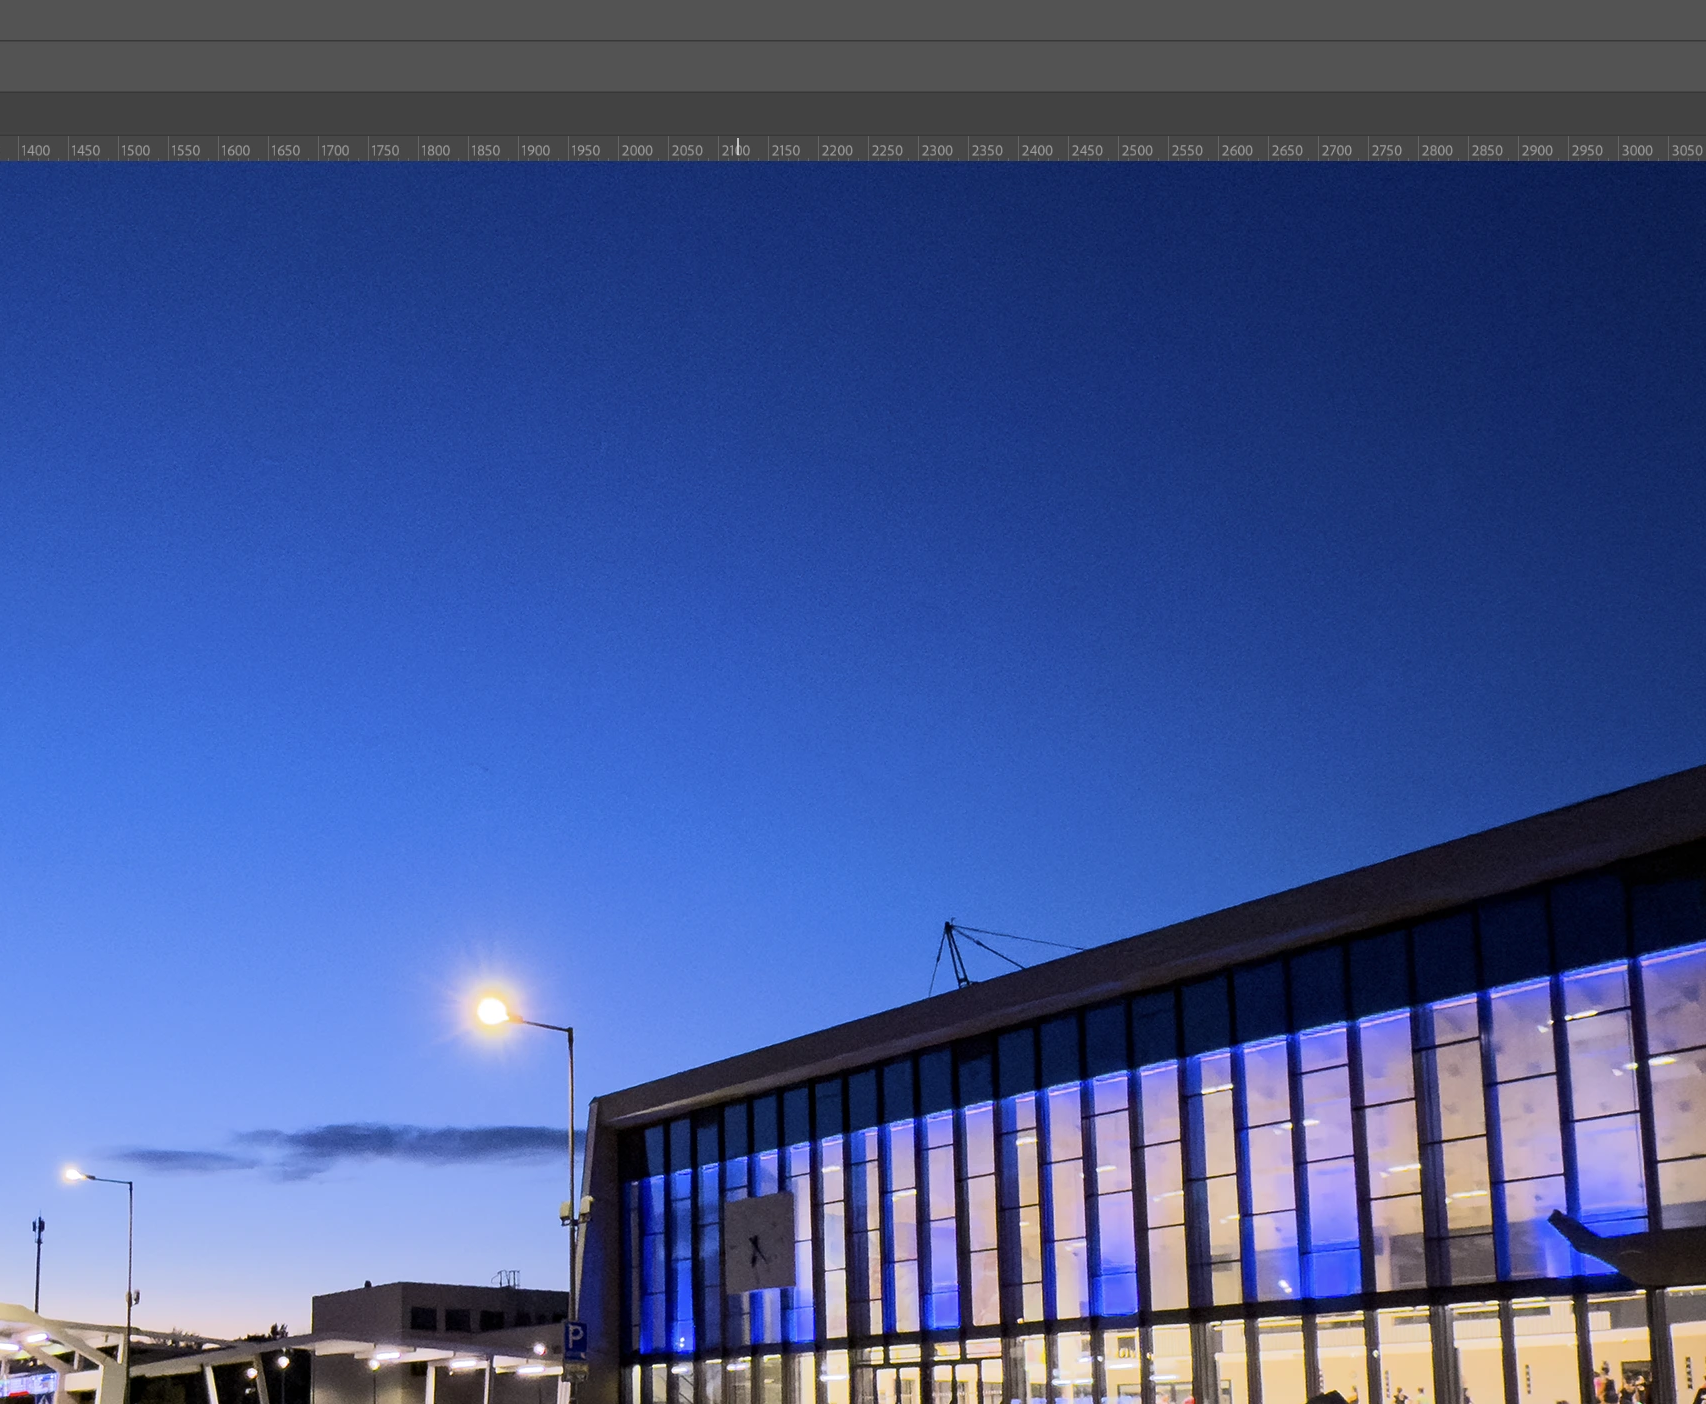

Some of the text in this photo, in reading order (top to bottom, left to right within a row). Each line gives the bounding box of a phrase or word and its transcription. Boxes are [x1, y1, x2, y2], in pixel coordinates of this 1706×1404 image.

[72, 145, 100, 156] 1450
[122, 145, 150, 156] 1500
[222, 145, 250, 156] 1600
[272, 145, 300, 156] 1650
[372, 145, 399, 156] 1750
[422, 145, 450, 156] 1800
[522, 145, 550, 156] 1900
[572, 145, 600, 156] 1950
[673, 145, 703, 156] 2050
[723, 145, 750, 156] 2100
[823, 145, 853, 156] 2200
[873, 145, 902, 156] 2250
[973, 145, 1002, 156] 2350
[1023, 145, 1053, 156] 2400
[1123, 145, 1153, 156] 2500
[1173, 145, 1203, 156] 2550
[1273, 145, 1302, 156] 2650
[1323, 145, 1352, 156] 2700
[1423, 145, 1453, 156] 2800
[1473, 145, 1503, 156] 2850
[1573, 145, 1603, 156] 2950
[1623, 145, 1653, 156] 3000
[568, 1324, 584, 1349] P
